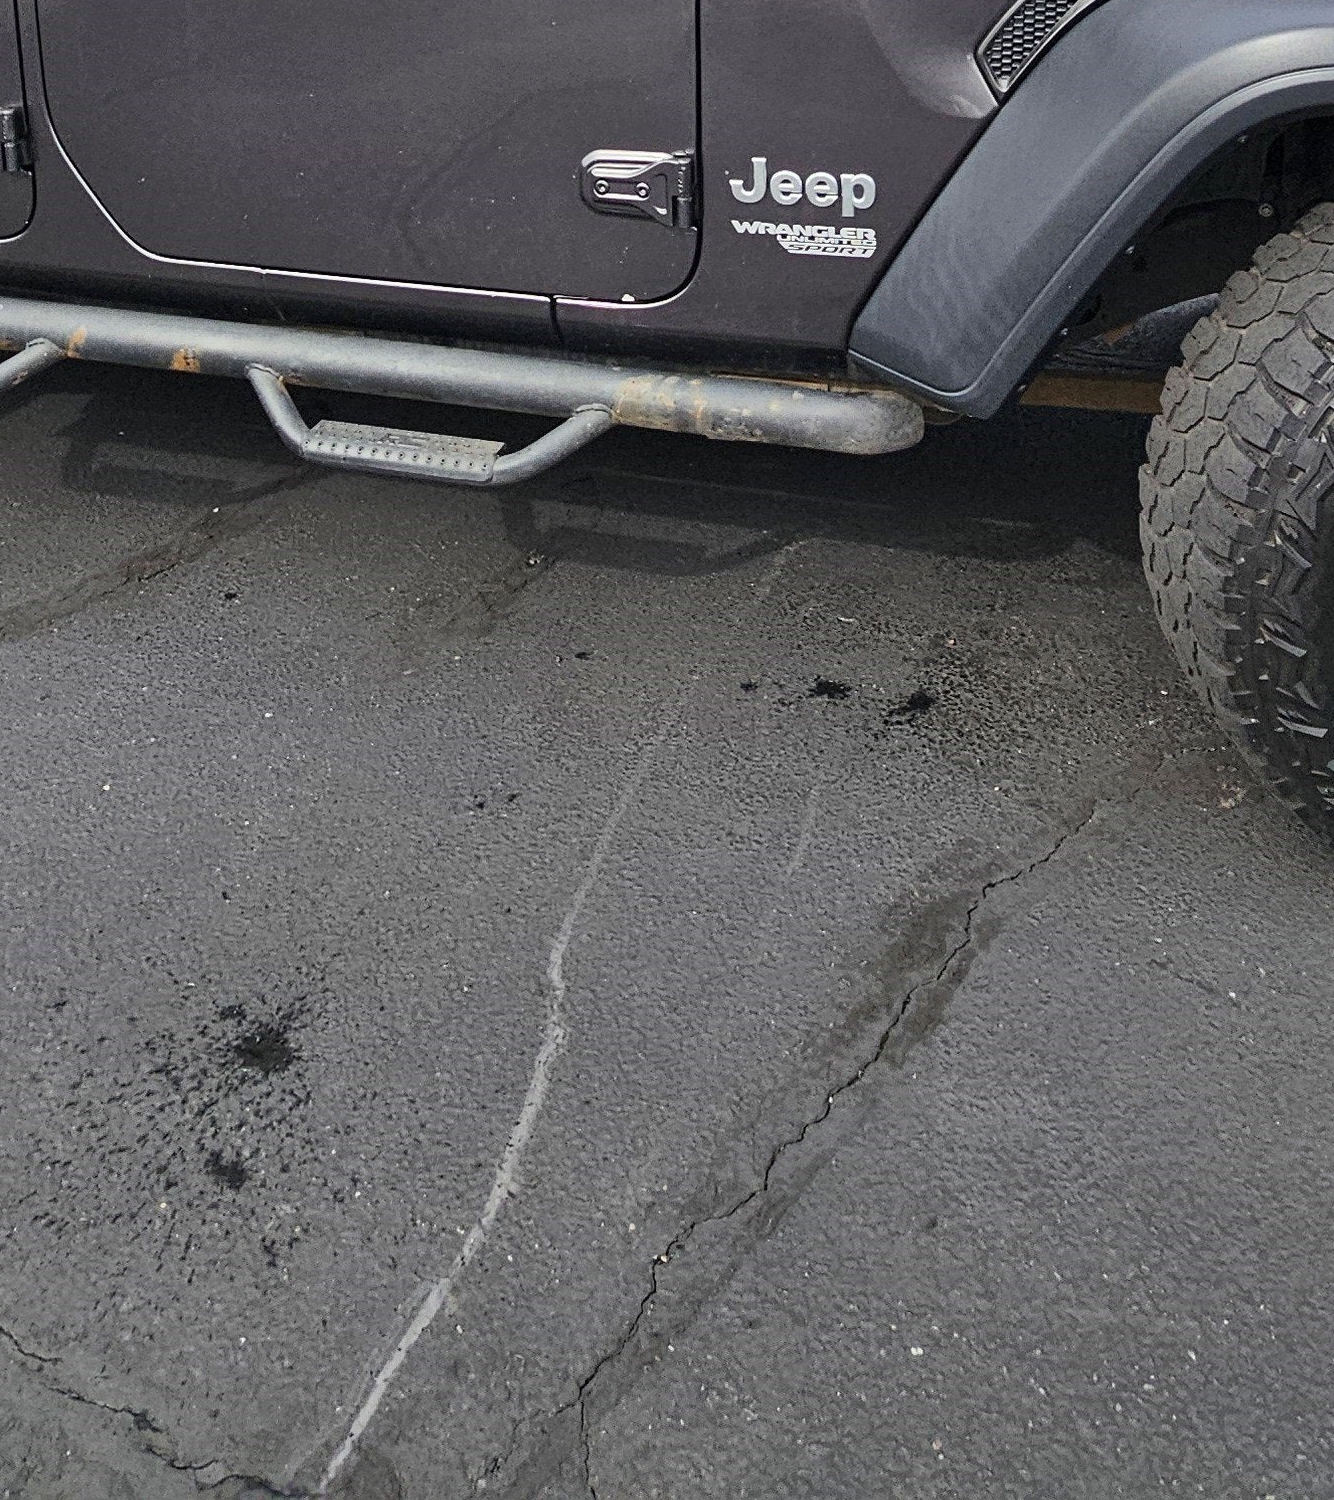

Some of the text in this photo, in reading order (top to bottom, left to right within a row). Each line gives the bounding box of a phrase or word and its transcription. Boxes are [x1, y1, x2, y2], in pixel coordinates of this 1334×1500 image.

[728, 156, 877, 217] Jeep
[730, 219, 877, 239] WRANGLER
[776, 234, 877, 246] UNLIMITED
[786, 243, 876, 256] SPORT
